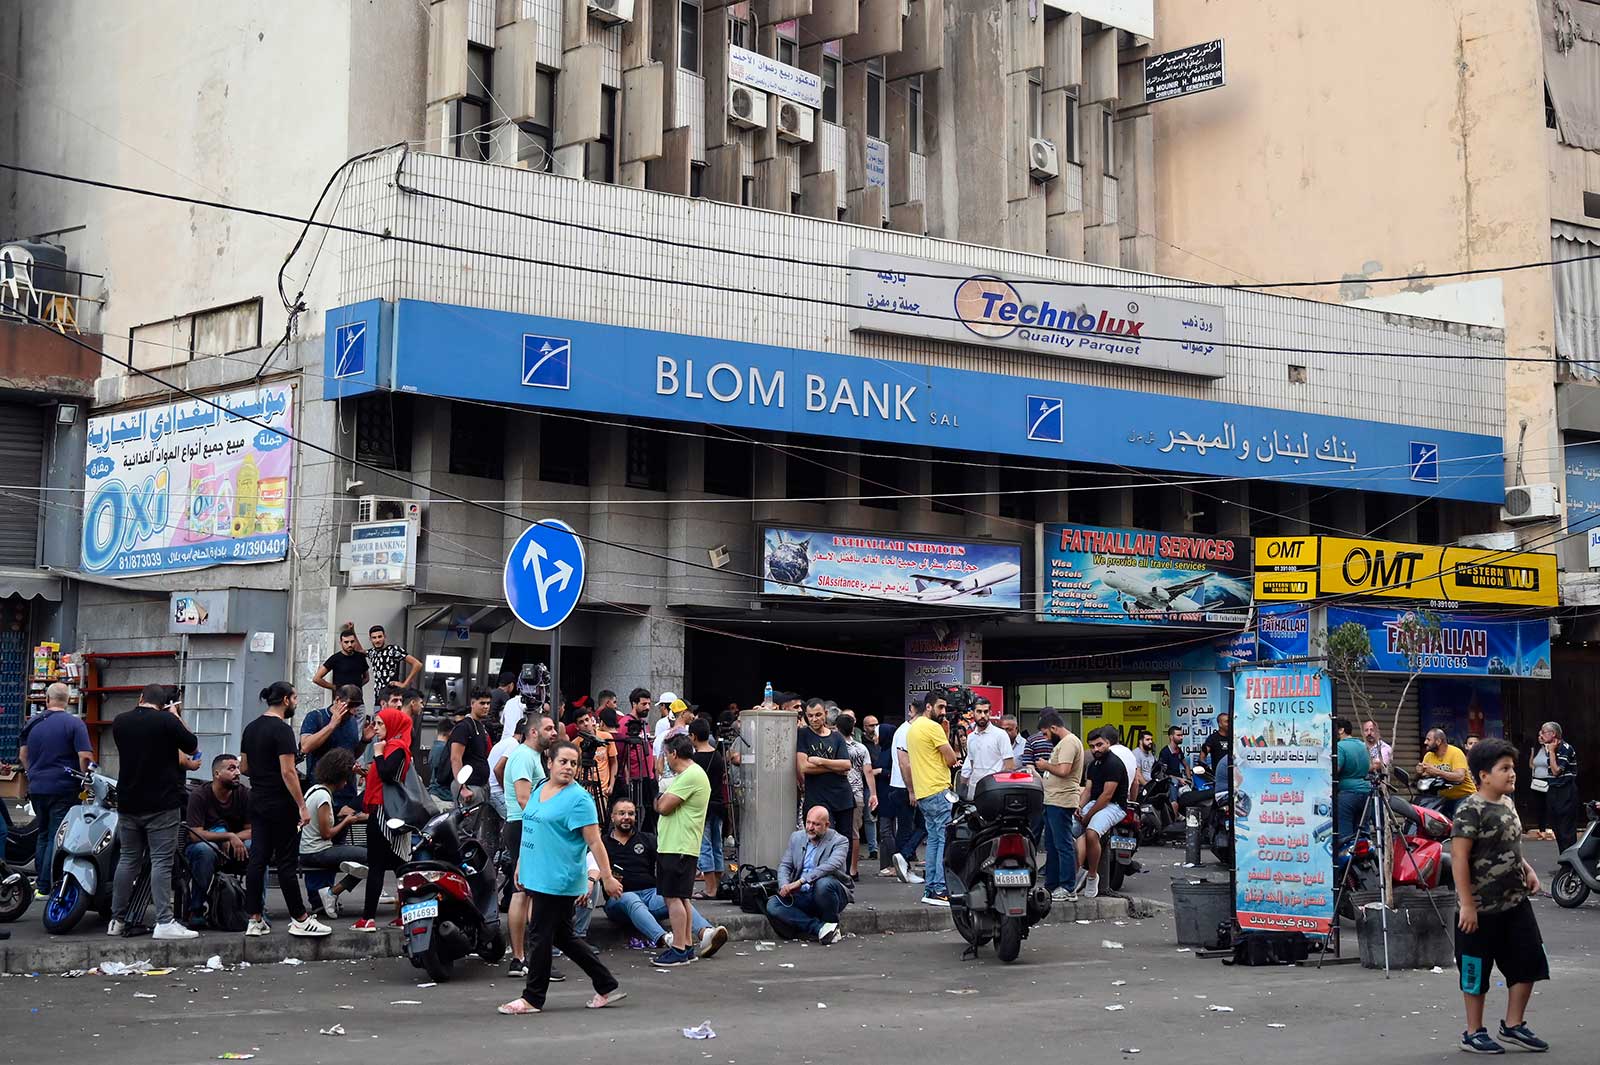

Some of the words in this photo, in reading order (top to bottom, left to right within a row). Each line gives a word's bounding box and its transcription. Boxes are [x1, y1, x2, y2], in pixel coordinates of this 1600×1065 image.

[1156, 81, 1179, 92] MOUNIR
[1192, 71, 1222, 84] MANSOUR
[1185, 80, 1213, 92] GENERALE
[867, 293, 890, 309] مفرق
[899, 296, 920, 314] جملة
[980, 291, 1145, 337] Technolux
[1018, 328, 1074, 348] Quality
[1078, 337, 1141, 356] Parquet
[656, 355, 785, 408] BLOM
[806, 373, 918, 423] BANK
[929, 411, 960, 428] SAL
[224, 388, 287, 422] مؤسسة
[150, 396, 222, 449] البغدادي
[88, 411, 147, 453] التجارية
[259, 432, 283, 447] جملة
[1159, 421, 1250, 461] والمهجر
[156, 446, 179, 464] المواد
[203, 441, 224, 459] جميع
[226, 438, 245, 455] مبيع
[1256, 430, 1309, 464] لبنان
[1315, 435, 1358, 471] بنك
[91, 461, 109, 475] مفرق
[232, 538, 287, 557] 81/390401
[832, 536, 905, 551] FATHALLAH
[907, 541, 966, 556] SERVICES
[1061, 529, 1157, 556] FATHALLAH
[1160, 536, 1235, 561] SERVICES
[1267, 541, 1305, 559] OMT
[118, 552, 162, 570] 81/873039
[1051, 560, 1072, 568] Visa
[1093, 555, 1106, 565] We
[1106, 556, 1137, 568] provide
[1139, 557, 1148, 567] all
[1150, 559, 1173, 569] travel
[1174, 562, 1207, 571] services
[1342, 547, 1424, 589] OMT
[1051, 569, 1082, 578] Hotels
[1458, 564, 1504, 577] WESTERN
[1509, 568, 1535, 589] WU
[1051, 580, 1092, 590] Transfer
[1291, 582, 1306, 593] WU
[1472, 575, 1504, 587] UNION
[1051, 590, 1098, 601] Packages
[1084, 601, 1109, 609] Moon
[1261, 618, 1307, 632] FATHALLAH
[1246, 674, 1321, 699] FATHALLAH
[1176, 705, 1189, 717] من
[1191, 704, 1214, 717] شحن
[1253, 700, 1315, 714] SERVICES
[1285, 811, 1306, 828] حجز
[1258, 850, 1294, 862] COVID
[1296, 852, 1310, 863] 19
